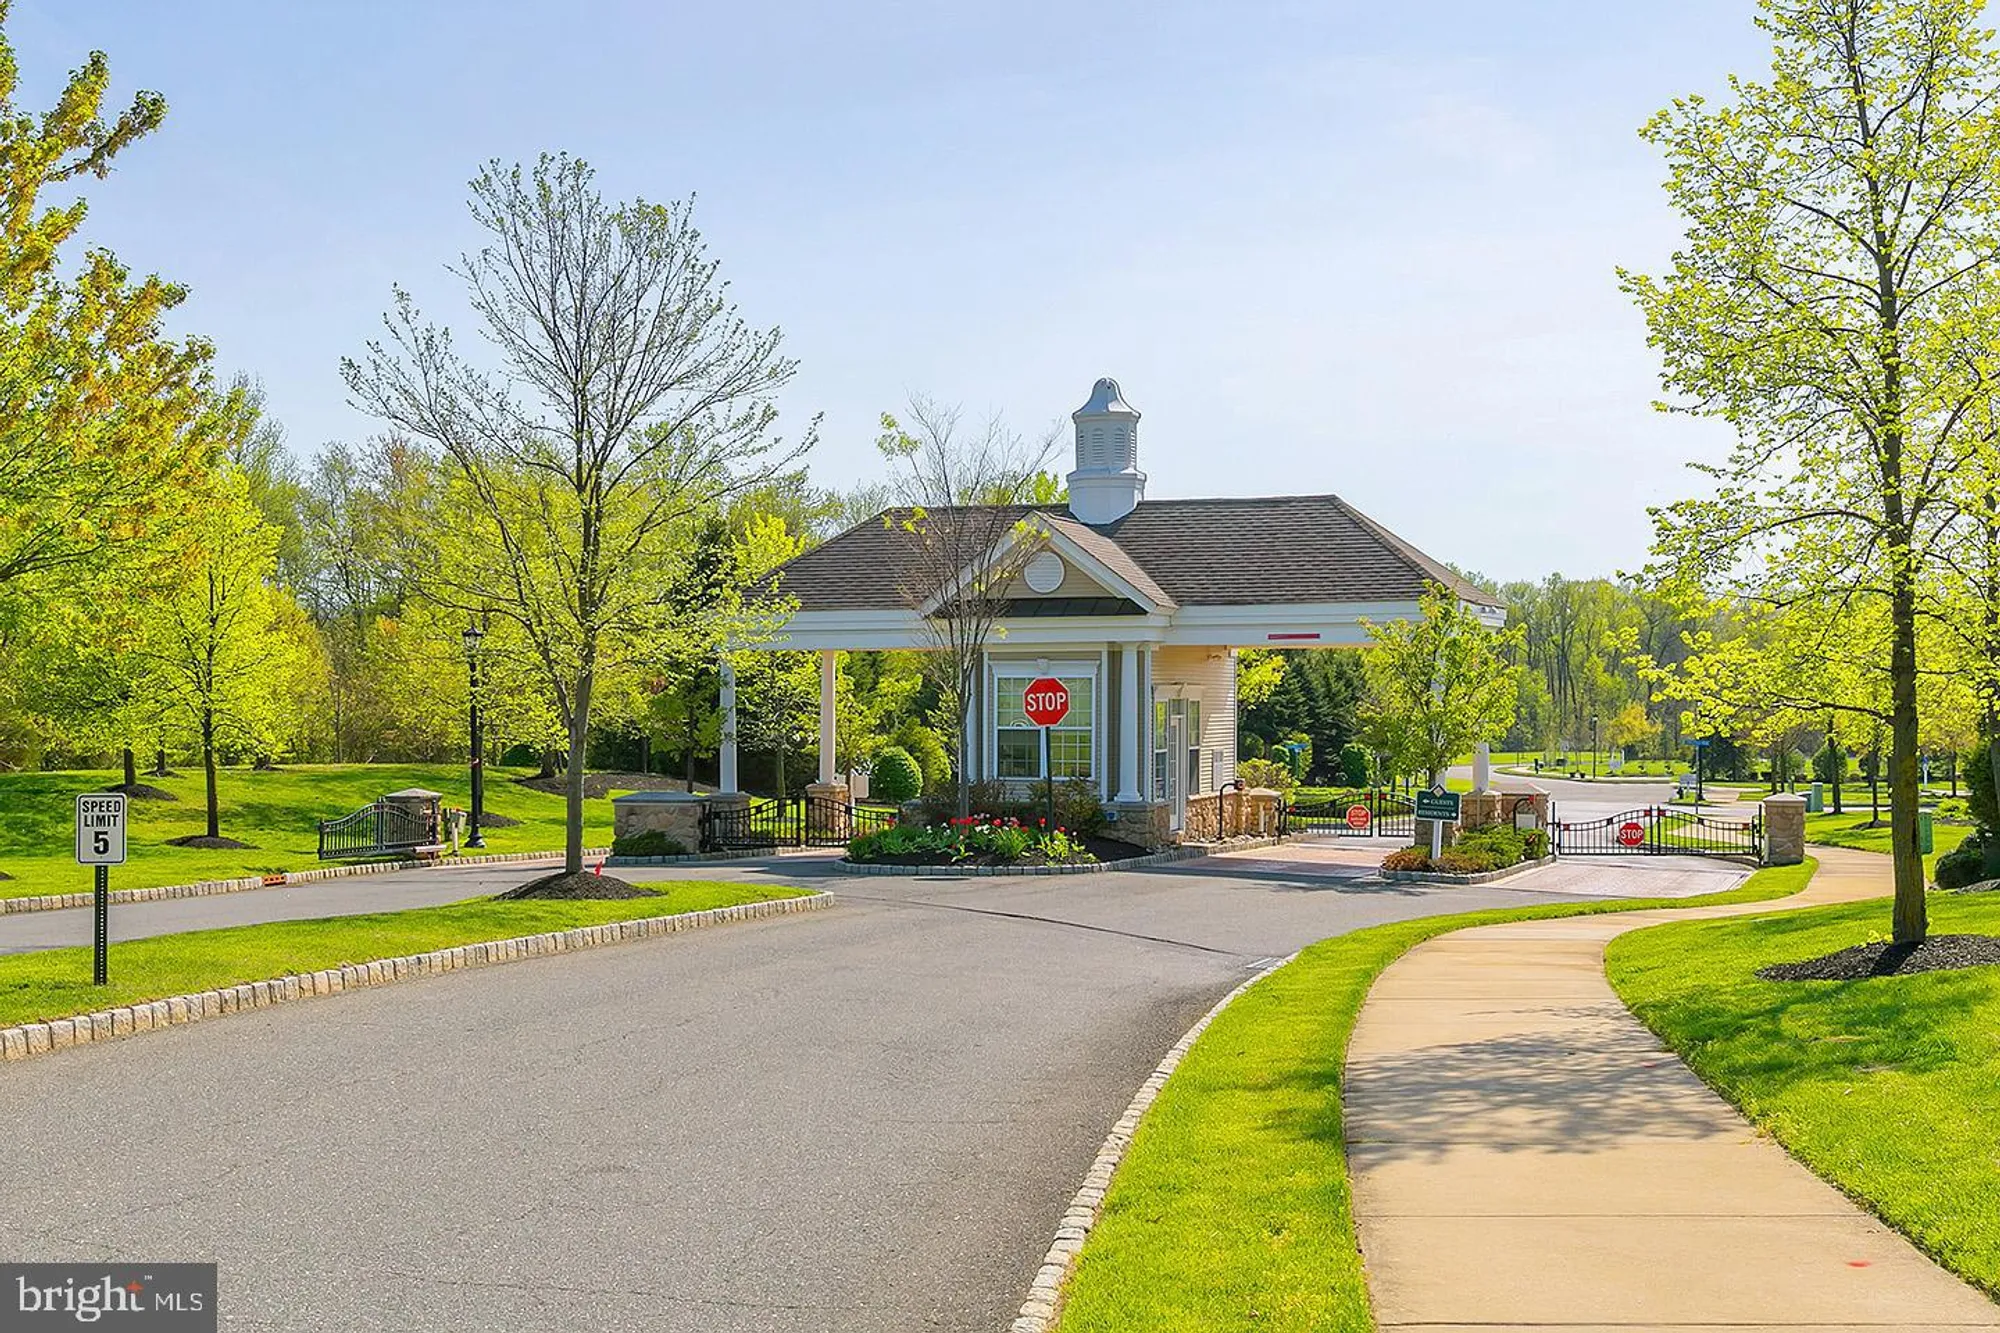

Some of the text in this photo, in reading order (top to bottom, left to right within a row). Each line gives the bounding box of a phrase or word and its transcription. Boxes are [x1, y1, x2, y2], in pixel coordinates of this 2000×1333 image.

[1027, 692, 1066, 711] STOP
[82, 800, 121, 813] SPEED
[1430, 798, 1454, 806] GUESTS
[84, 814, 119, 827] LIMIT
[1620, 829, 1643, 839] STOP
[93, 830, 110, 855] 5
